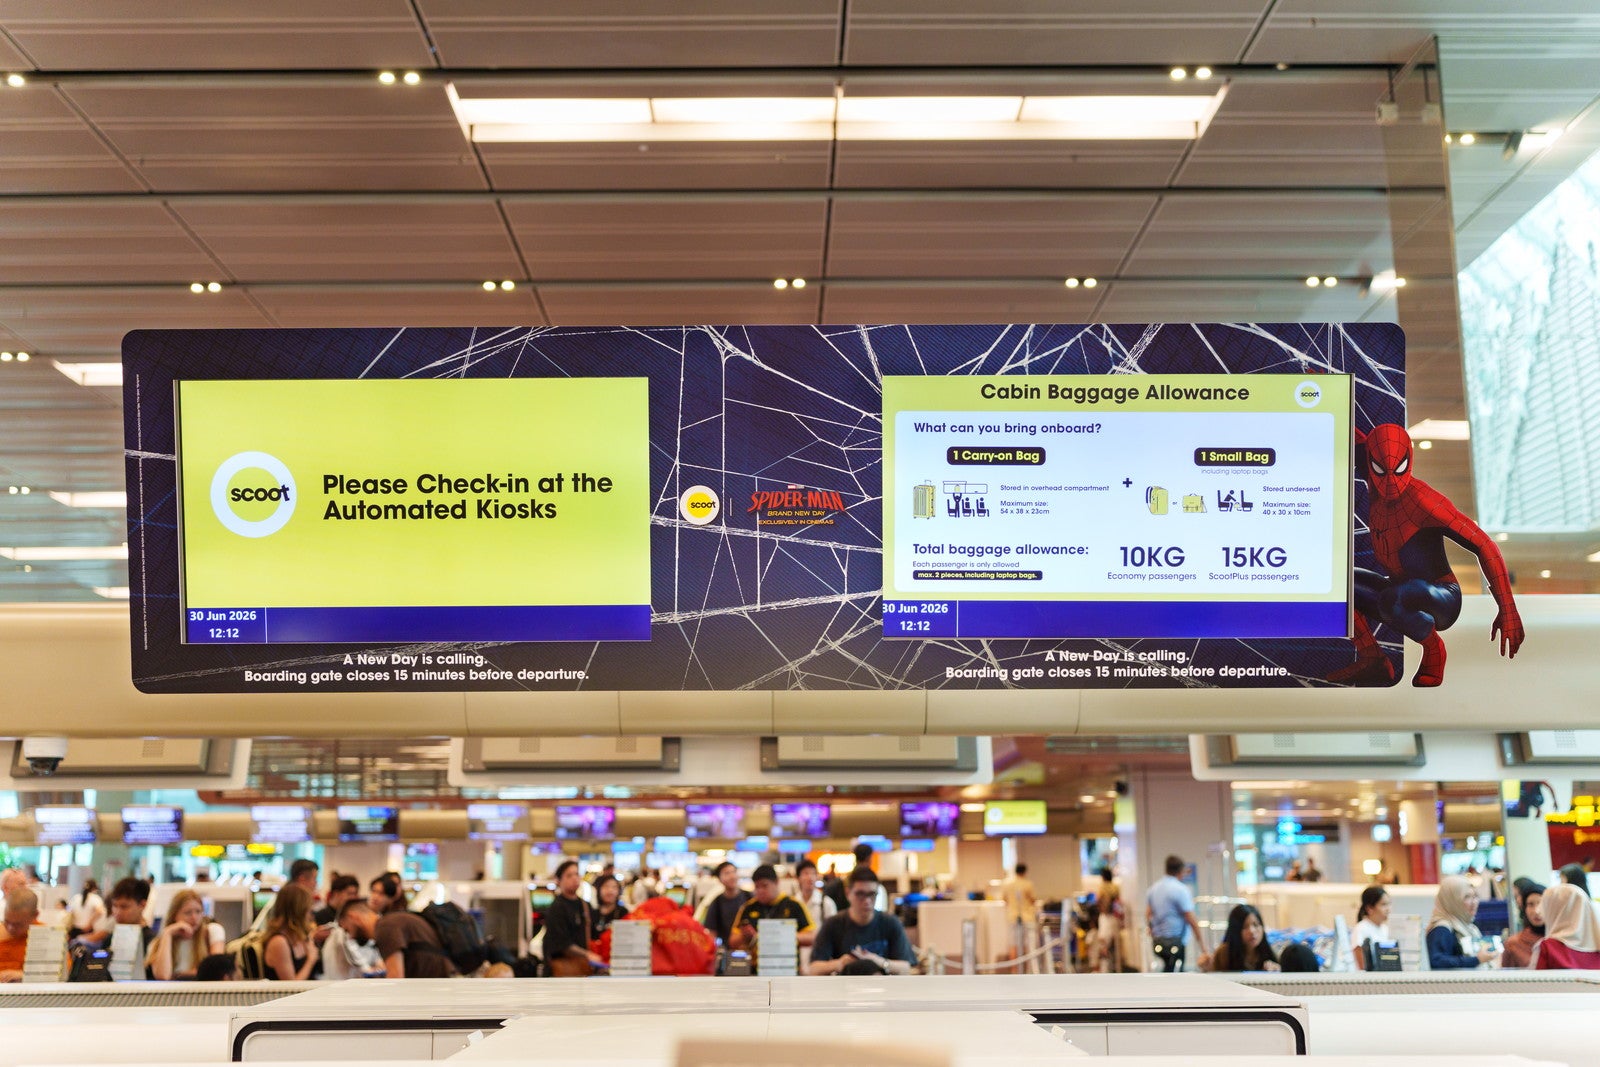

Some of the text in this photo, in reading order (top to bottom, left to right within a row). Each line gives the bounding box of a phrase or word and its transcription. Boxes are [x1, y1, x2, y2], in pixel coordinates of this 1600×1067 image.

[981, 384, 1250, 404] Cabin Baggage Allowance
[914, 422, 1102, 436] What can you bring onboard?
[953, 450, 1040, 463] 1 Carry-on Bag
[1201, 451, 1269, 464] 1 Small Bag
[323, 472, 613, 494] Please Check-in at the
[230, 484, 290, 502] scoot
[690, 499, 716, 509] scoot
[747, 491, 846, 512] SPIDER-MAN
[323, 500, 557, 520] Automated Kiosks
[912, 544, 1089, 558] Total baggage allowance:
[1120, 546, 1186, 568] 10KG
[1222, 546, 1288, 568] 15KG
[976, 561, 992, 569] only
[1108, 572, 1196, 582] Economy passengers
[1208, 572, 1300, 582] ScootPlus passengers
[190, 610, 256, 622] 30 Jun 2026
[898, 604, 918, 614] Jun
[920, 604, 948, 614] 2026
[208, 628, 240, 638] 12:12
[900, 621, 930, 631] 12:12
[343, 652, 488, 668] A New Day is calling.
[1044, 650, 1190, 664] A New Day is calling.
[244, 668, 590, 684] Boarding gate closes 15 minutes before departure.
[946, 665, 1291, 681] Boarding gate closes 15 minutes before departure.
